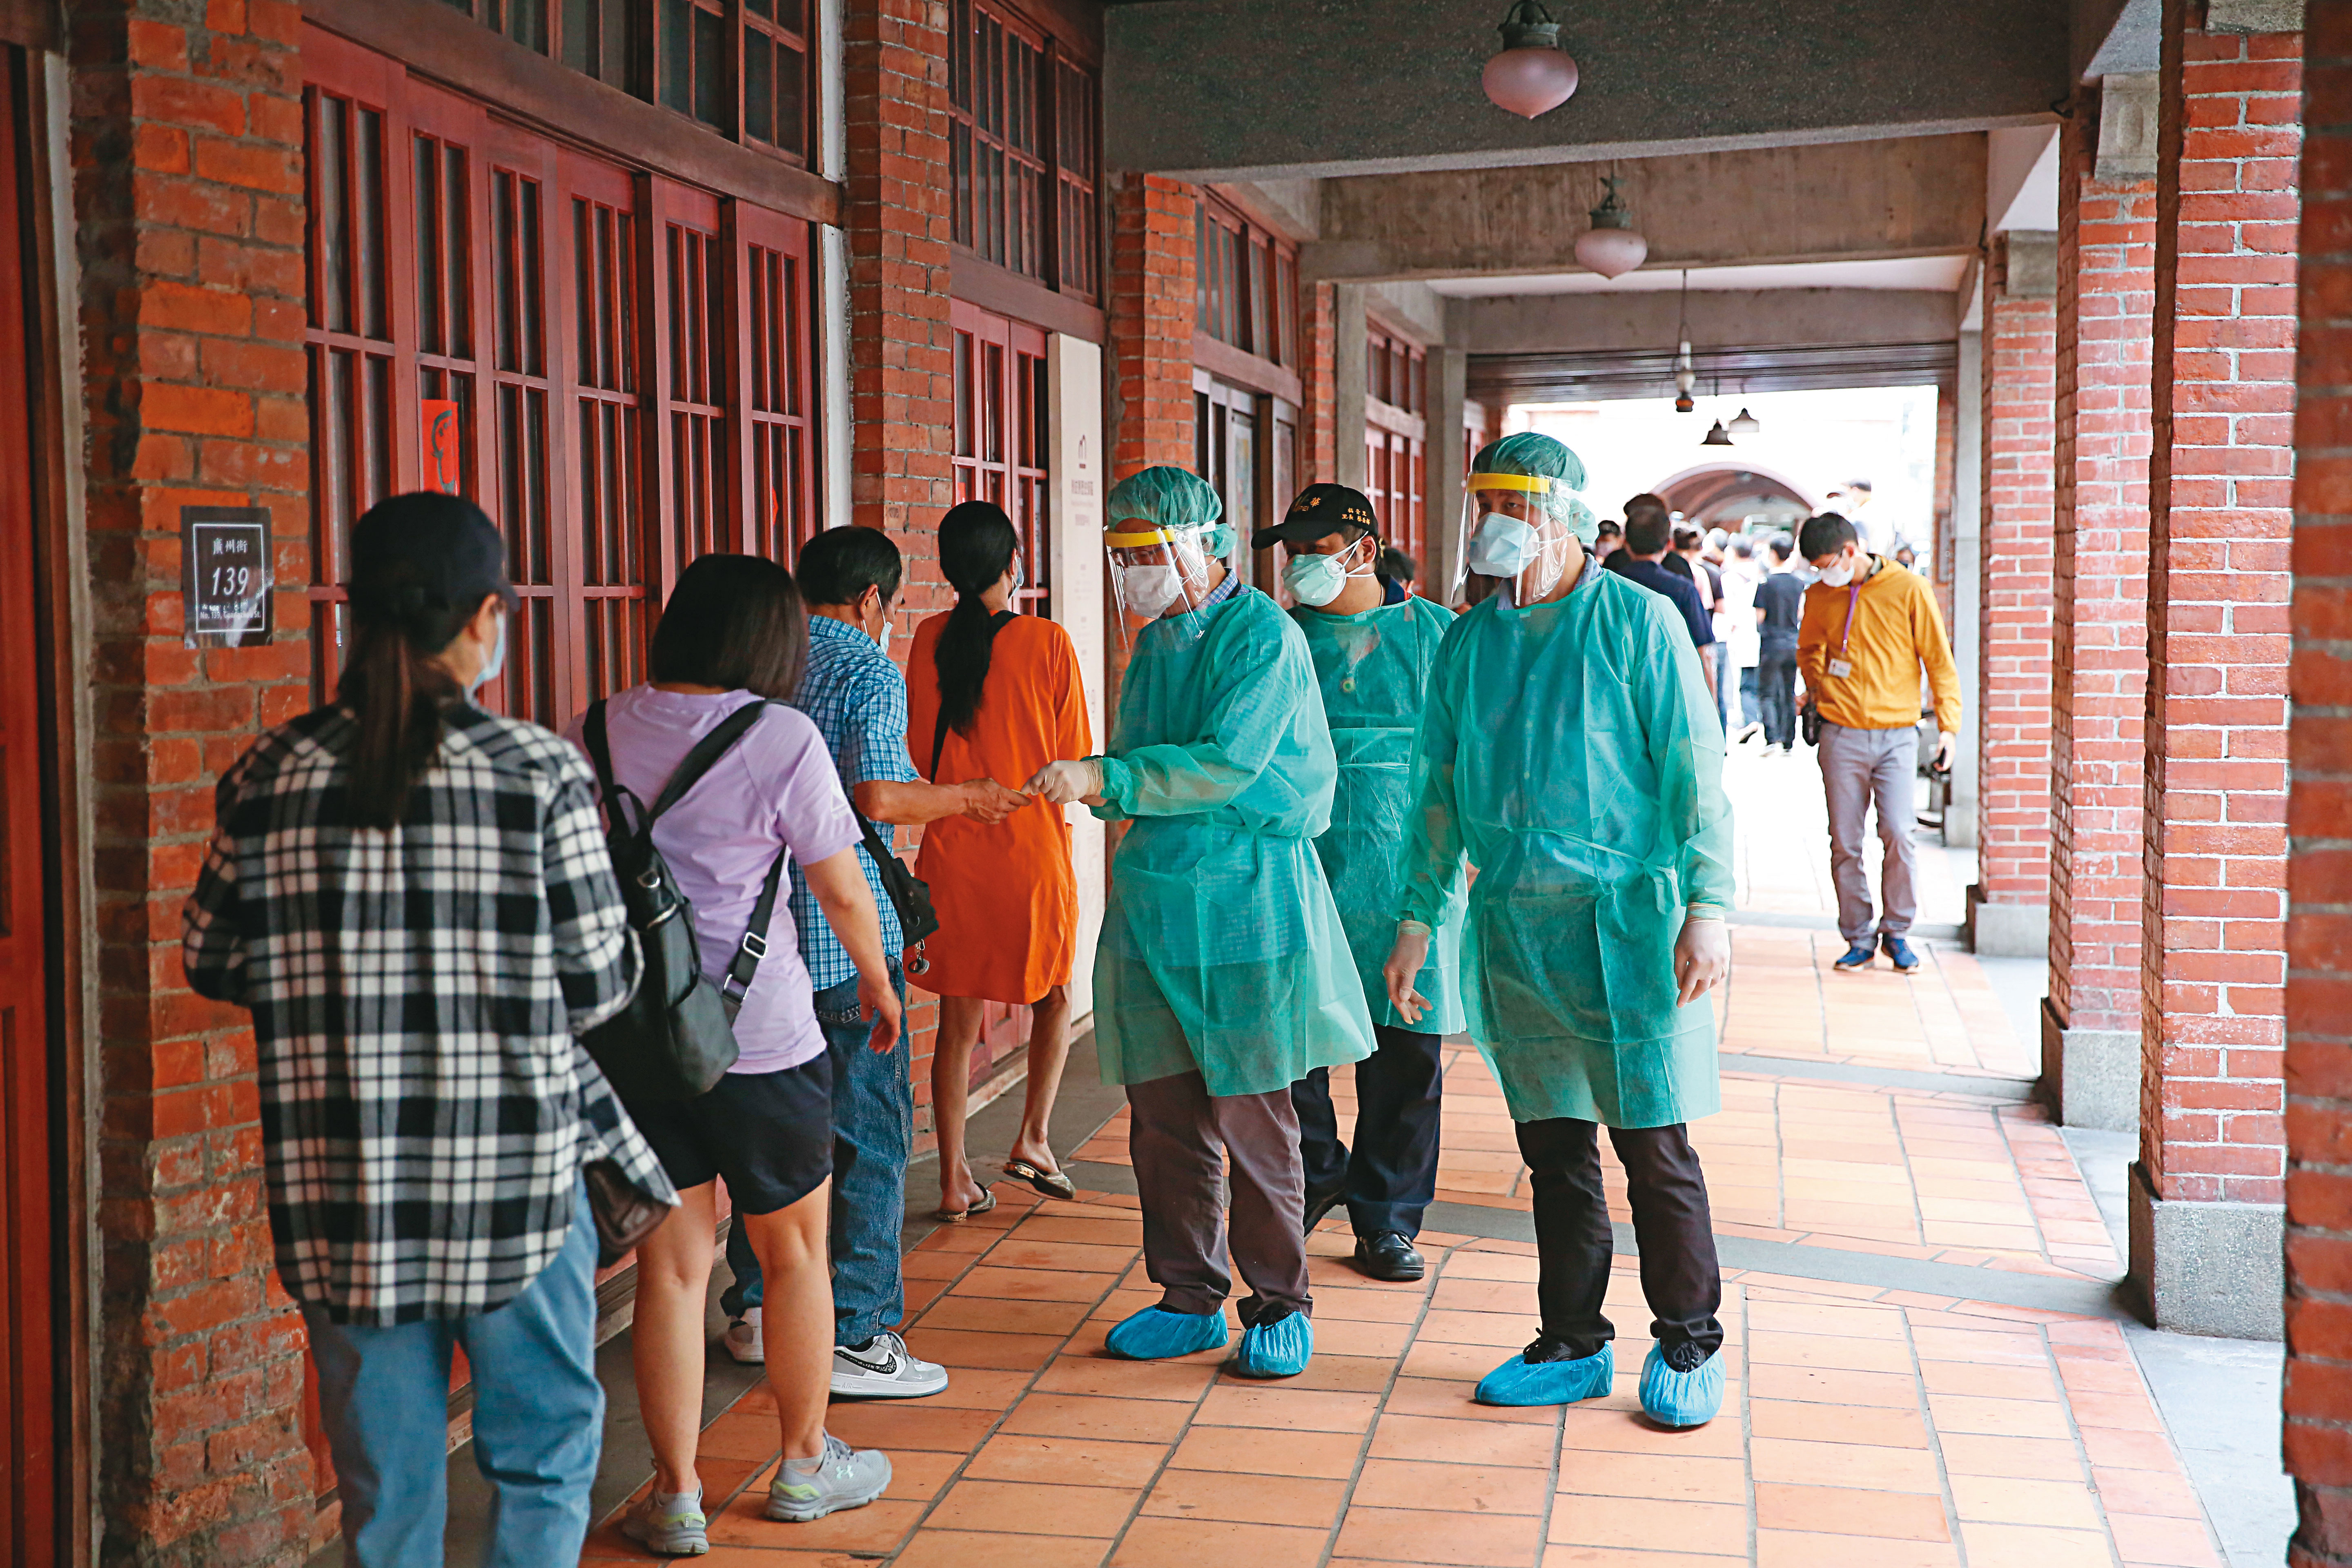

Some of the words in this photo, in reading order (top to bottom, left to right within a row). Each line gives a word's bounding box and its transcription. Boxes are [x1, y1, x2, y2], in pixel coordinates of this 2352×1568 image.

[213, 538, 247, 555] 廣州街
[212, 567, 249, 596] 139
